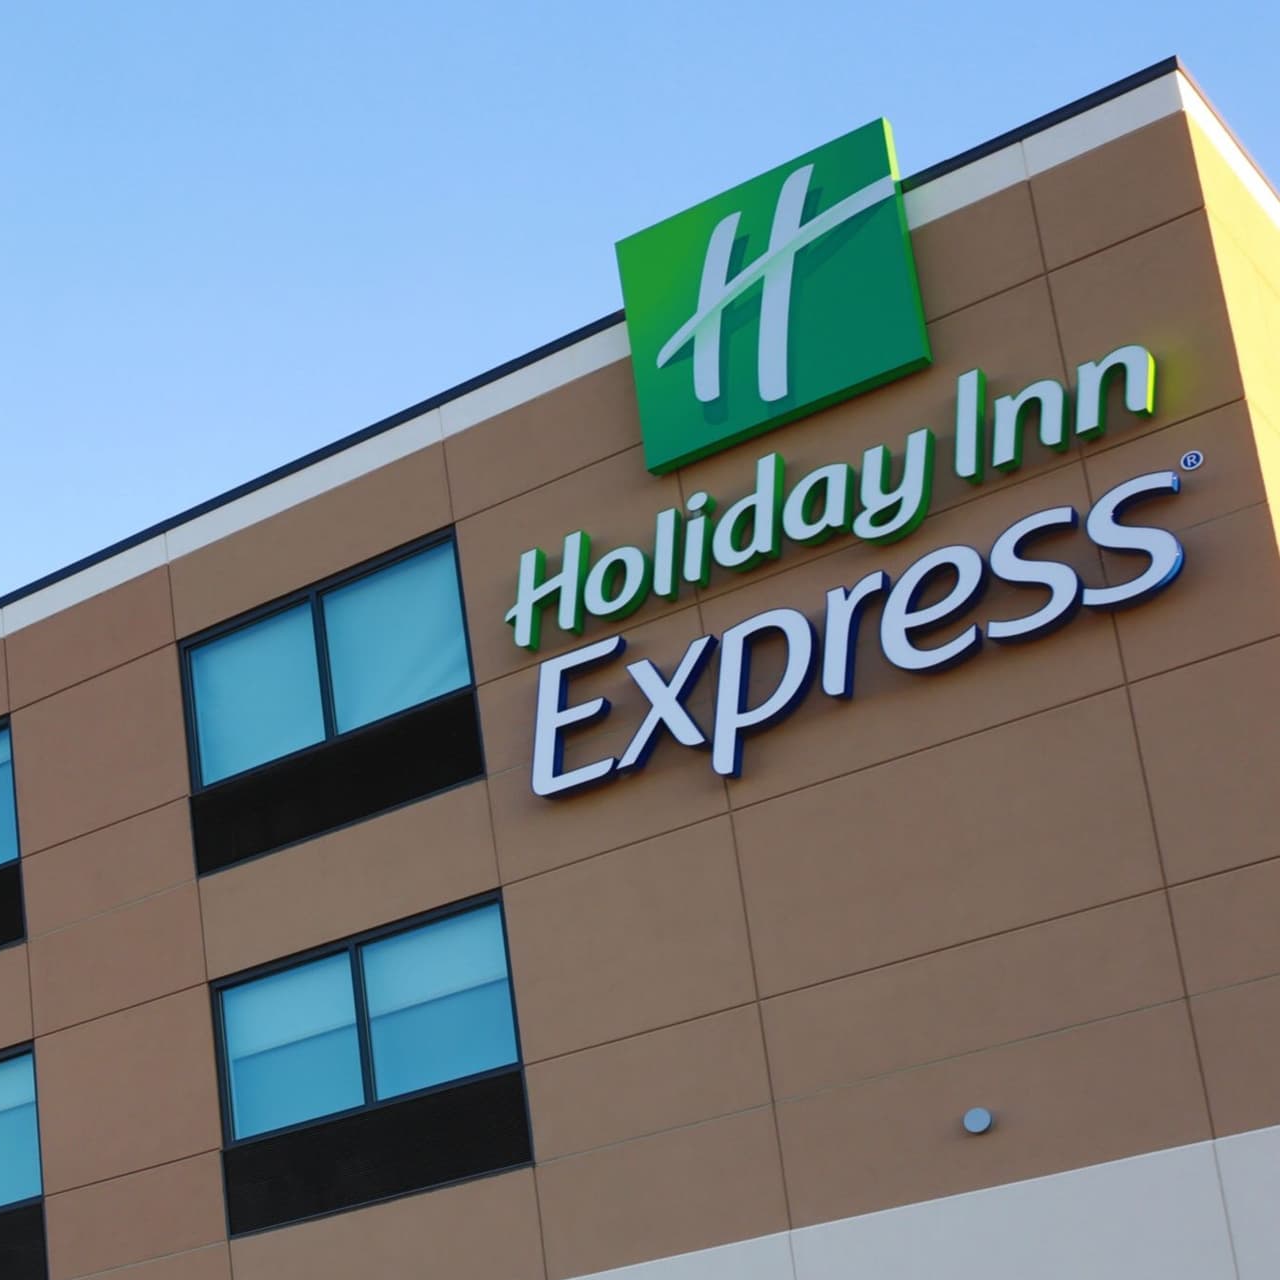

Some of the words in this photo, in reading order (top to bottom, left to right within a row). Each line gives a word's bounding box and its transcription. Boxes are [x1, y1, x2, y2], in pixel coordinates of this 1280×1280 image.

[505, 429, 935, 650] Holiday
[954, 344, 1156, 483] Inn
[531, 470, 1185, 798] Express
